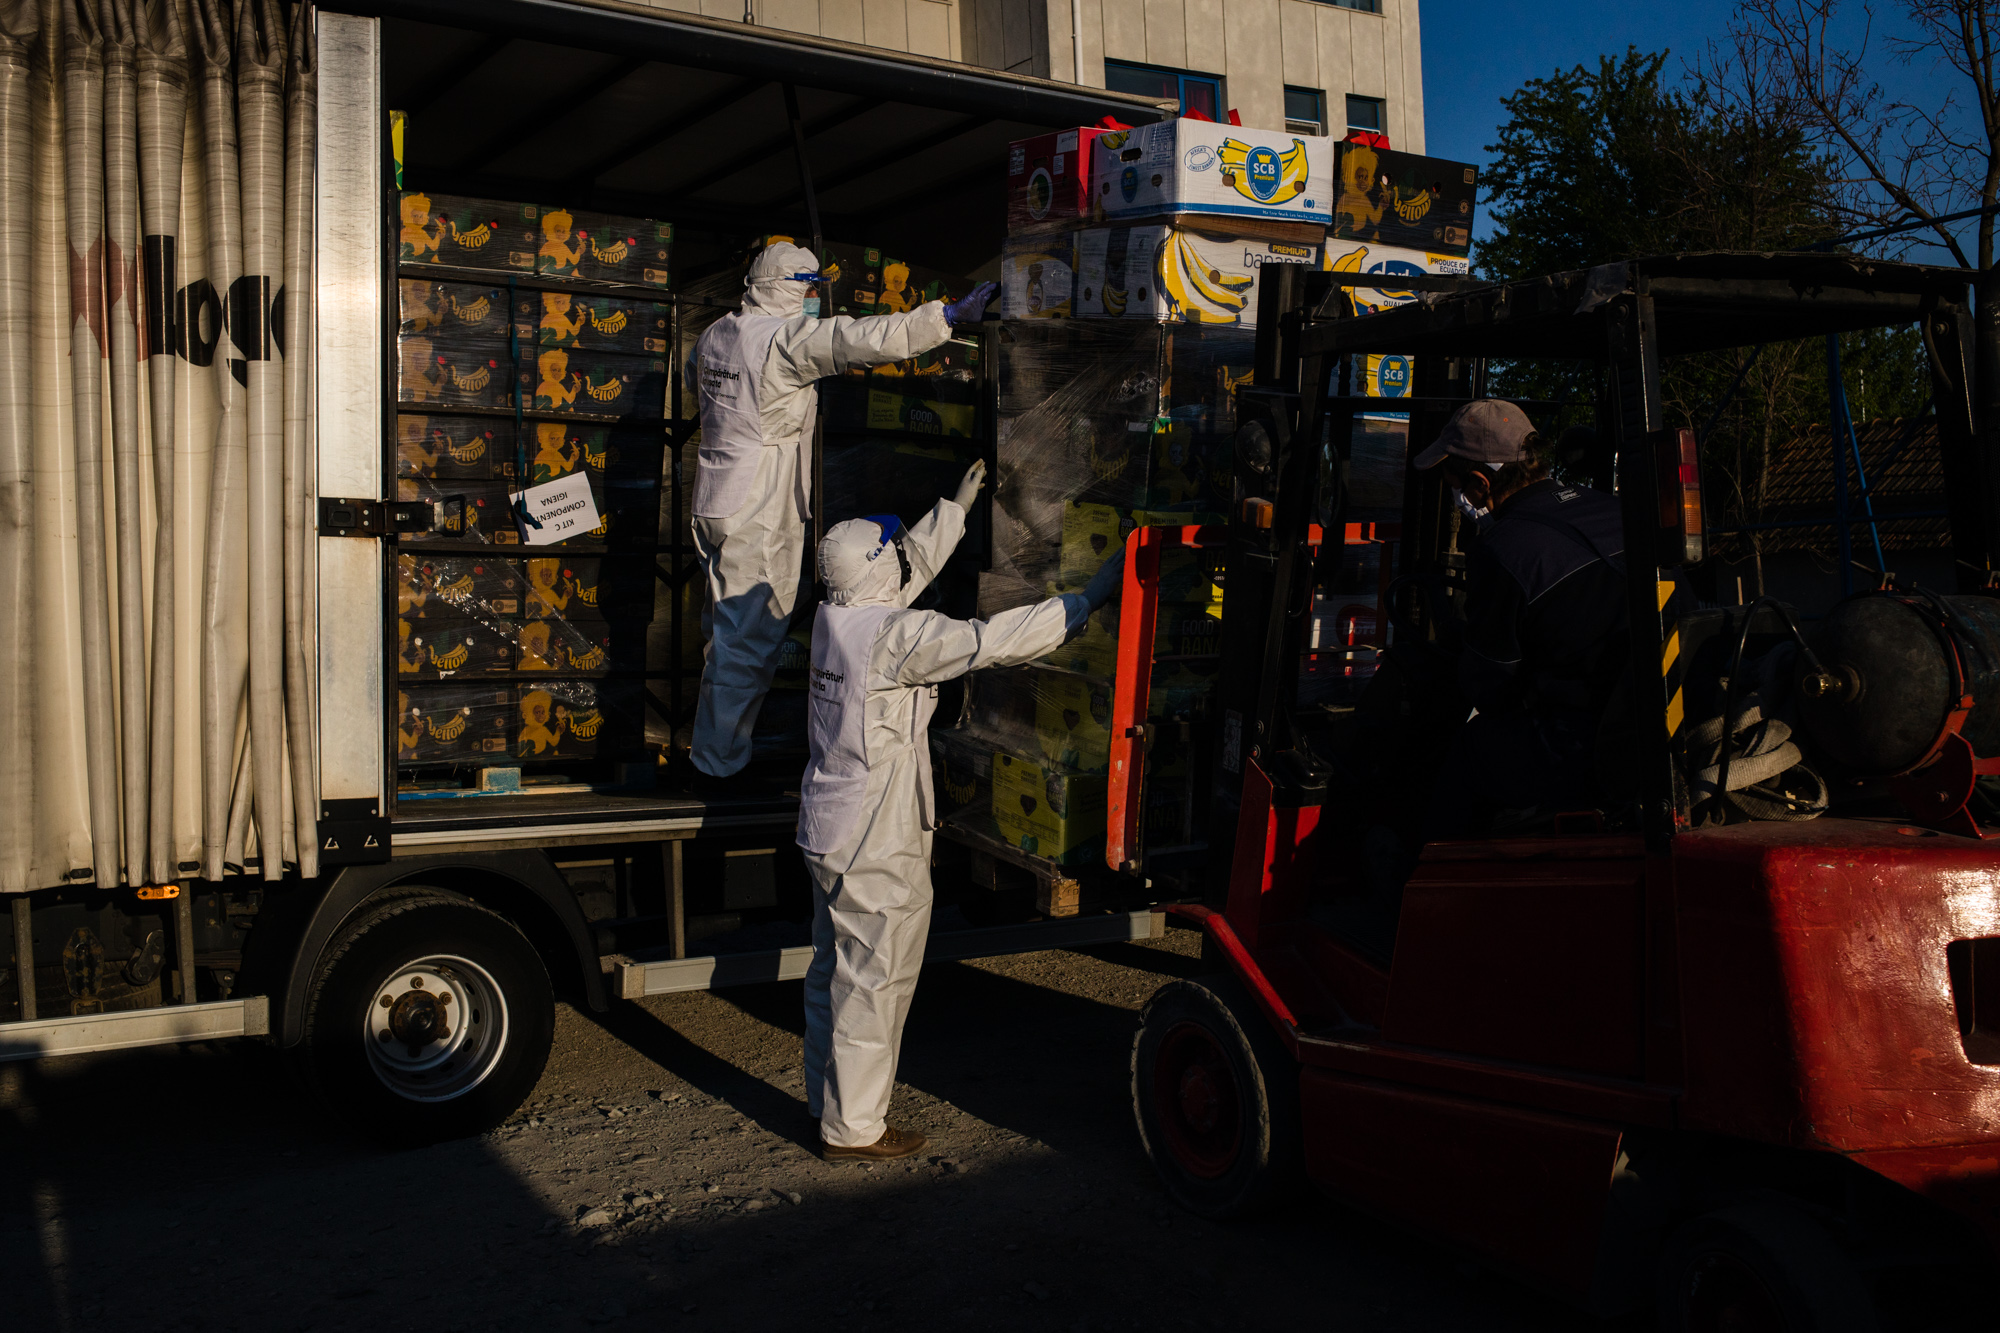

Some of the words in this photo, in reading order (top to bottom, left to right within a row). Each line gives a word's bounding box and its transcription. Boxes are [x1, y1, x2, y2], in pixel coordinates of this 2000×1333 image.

[1253, 162, 1275, 174] SCB
[1393, 185, 1431, 221] yellow
[450, 221, 491, 248] yellow
[590, 237, 628, 264] yellow
[1244, 247, 1312, 268] bana
[1272, 245, 1307, 257] PREMIUM
[1430, 257, 1458, 267] PRODUCE
[1439, 265, 1467, 274] ECUADOR
[451, 295, 491, 322] yellow
[1383, 300, 1408, 308] QUALI
[589, 308, 627, 334] yellow
[451, 365, 491, 392] yellow
[1384, 368, 1404, 381] SCB
[585, 375, 623, 402] yellow
[910, 409, 933, 423] GOOD
[447, 436, 486, 463] yellow
[540, 491, 568, 507] IGIENA
[533, 500, 586, 523] COMPONENT
[1149, 517, 1178, 525] PREMIUM
[554, 523, 561, 532] C
[562, 518, 575, 529] KIT
[1120, 526, 1133, 538] BAN
[1121, 518, 1134, 528] GOOD
[1182, 619, 1214, 636] GOOD
[429, 644, 468, 670] yellow
[567, 646, 605, 671] yellow
[427, 716, 466, 741] yellow
[942, 759, 977, 806] yellow
